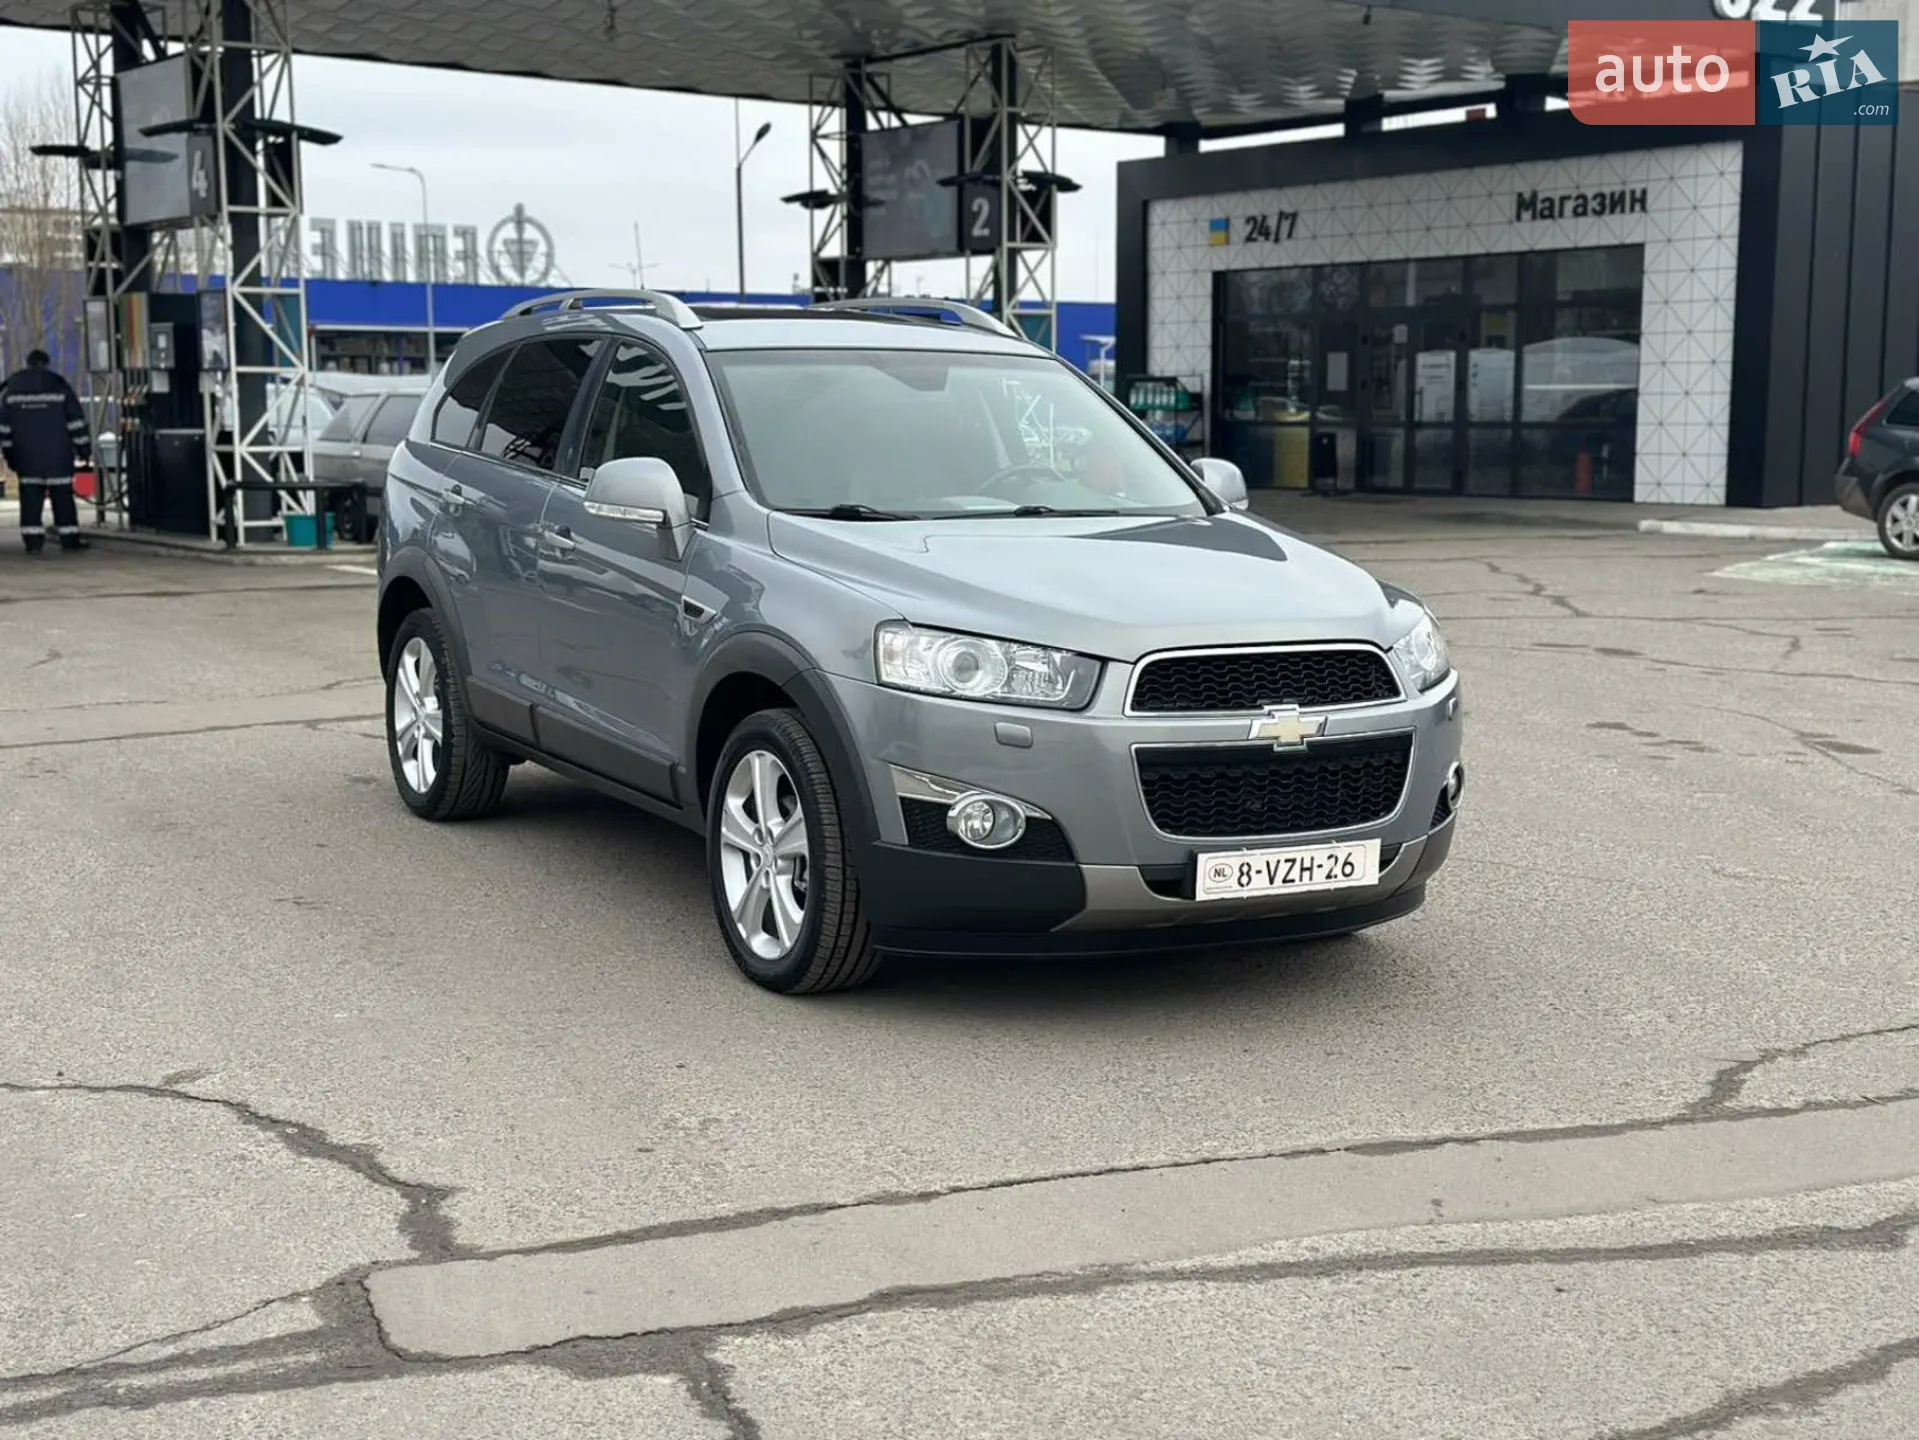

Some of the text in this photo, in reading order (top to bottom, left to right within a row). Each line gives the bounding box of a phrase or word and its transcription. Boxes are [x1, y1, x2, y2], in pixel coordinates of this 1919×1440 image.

[192, 150, 209, 198] 4
[971, 197, 990, 237] 2
[1515, 187, 1648, 222] Магазин
[1244, 211, 1298, 243] 24/7
[1213, 852, 1355, 888] NL 8-VZH-26
